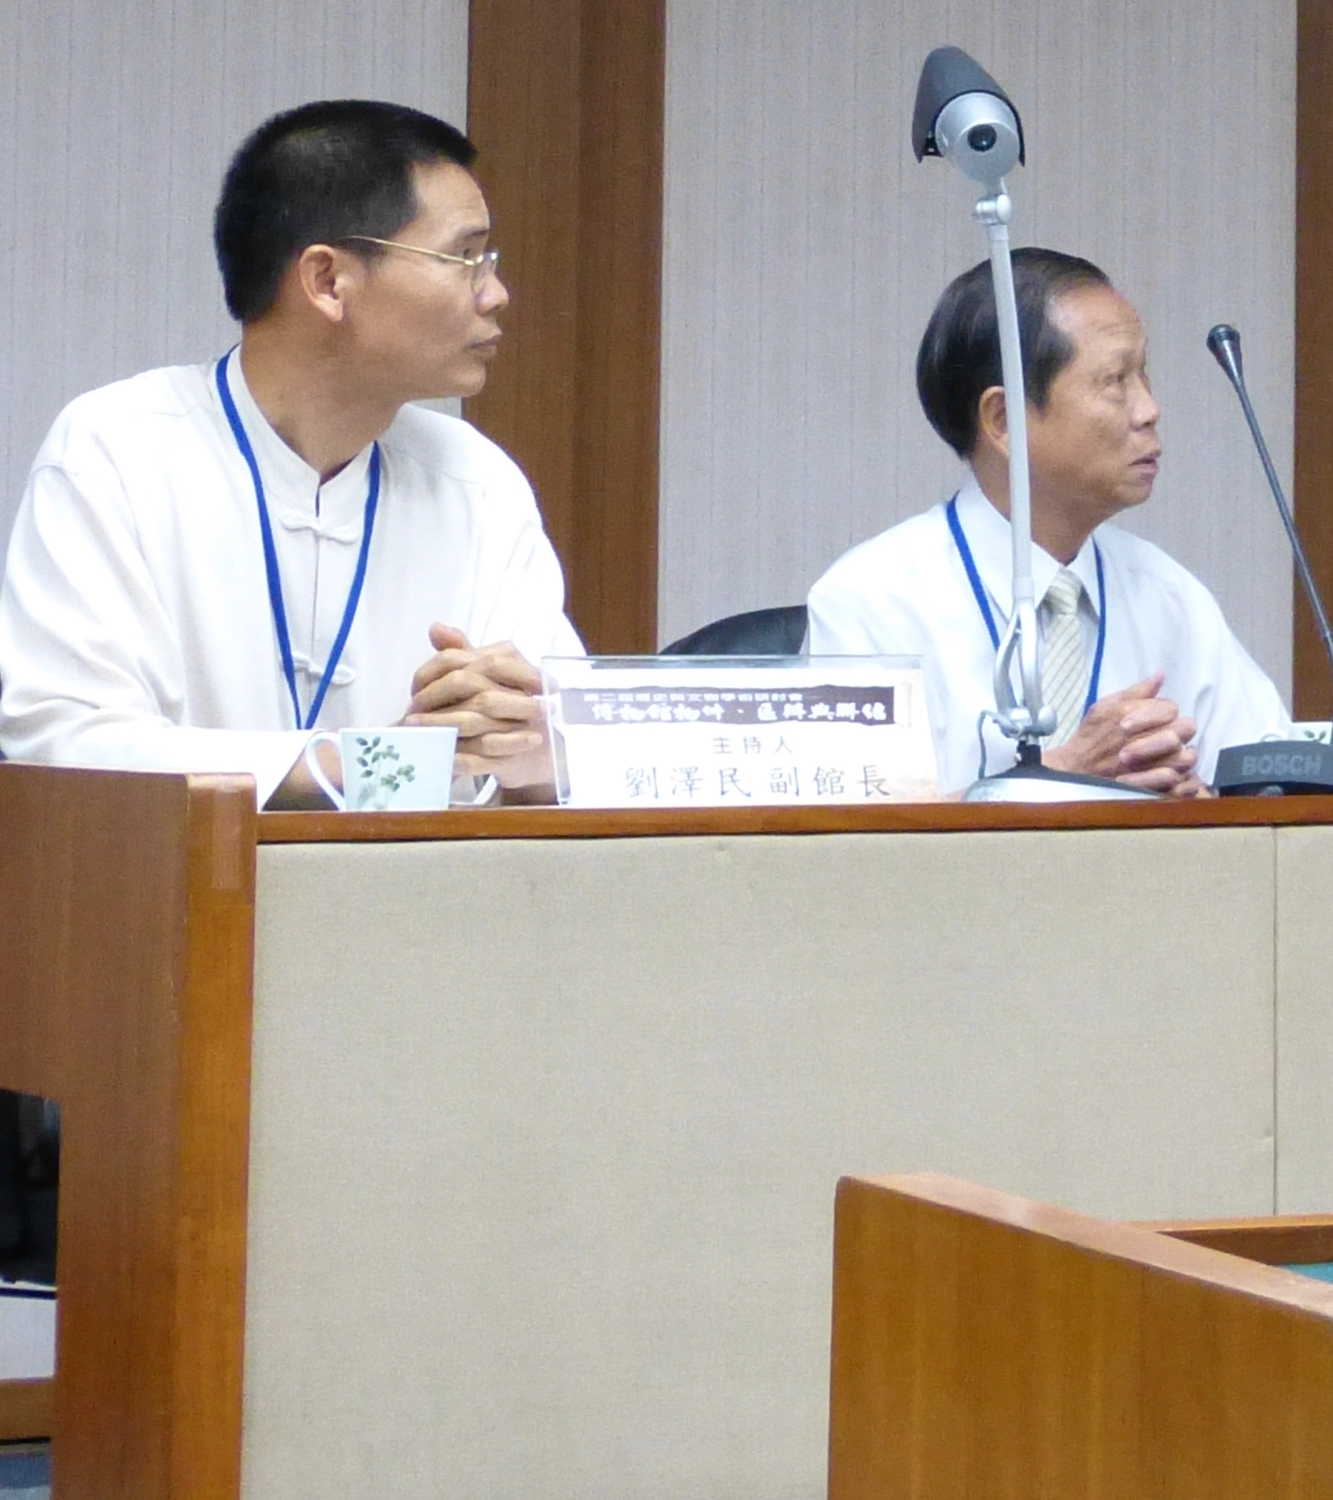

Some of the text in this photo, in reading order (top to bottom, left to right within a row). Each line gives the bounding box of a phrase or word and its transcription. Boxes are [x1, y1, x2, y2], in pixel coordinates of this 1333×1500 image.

[713, 735, 793, 754] 主持人
[1242, 753, 1321, 776] BOSCH
[625, 765, 892, 799] 劉澤民副館長
